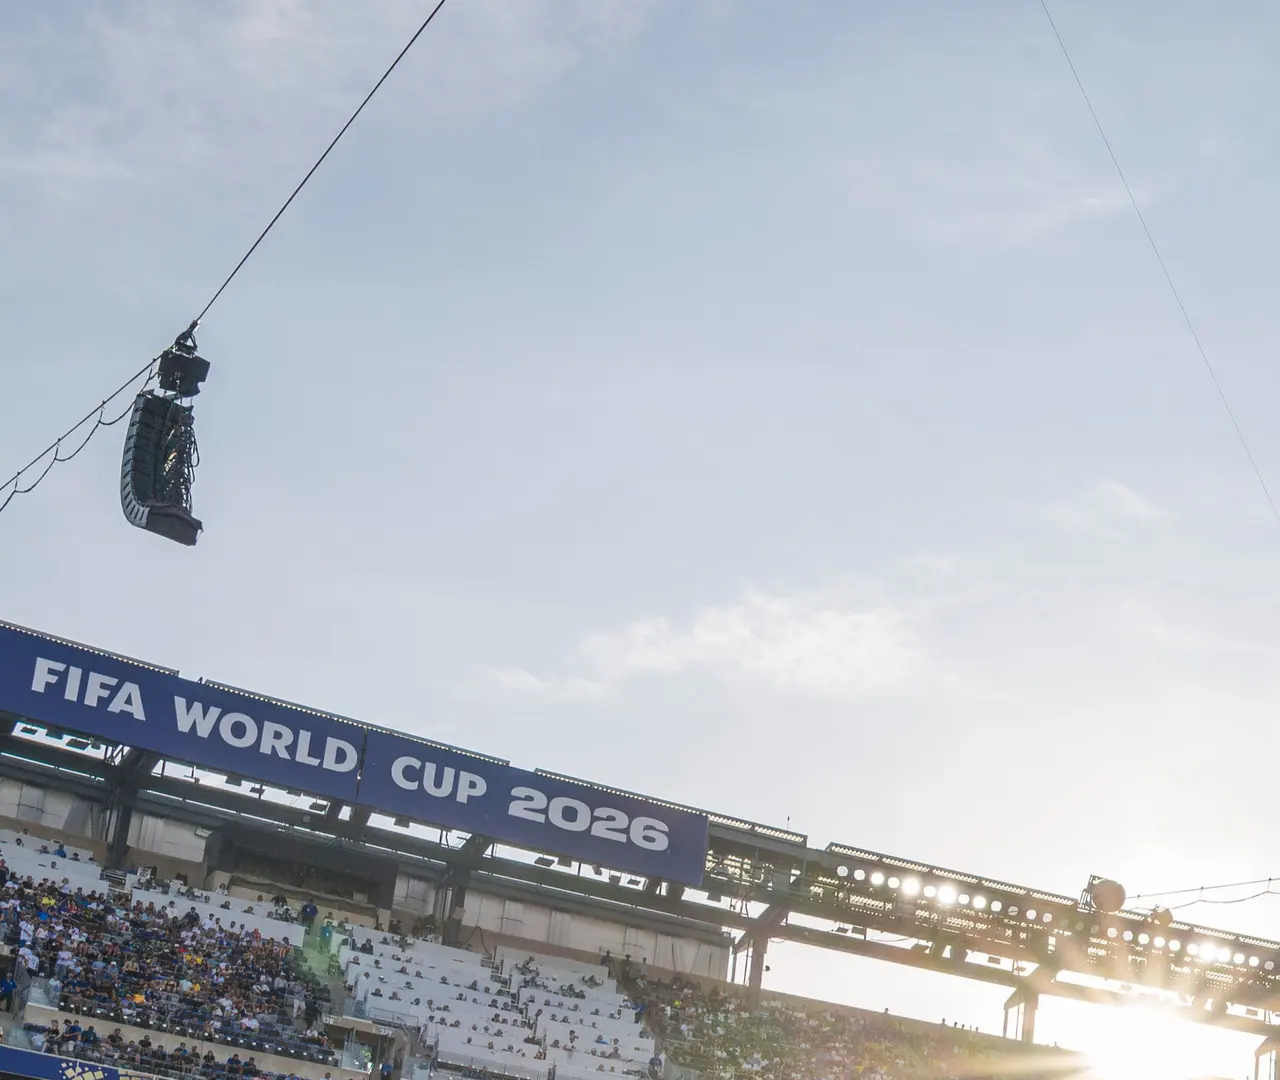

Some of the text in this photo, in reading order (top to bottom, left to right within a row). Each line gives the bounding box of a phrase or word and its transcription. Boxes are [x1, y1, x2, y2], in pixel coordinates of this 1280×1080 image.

[31, 656, 669, 851] FIFA WORLD CUP 2026
